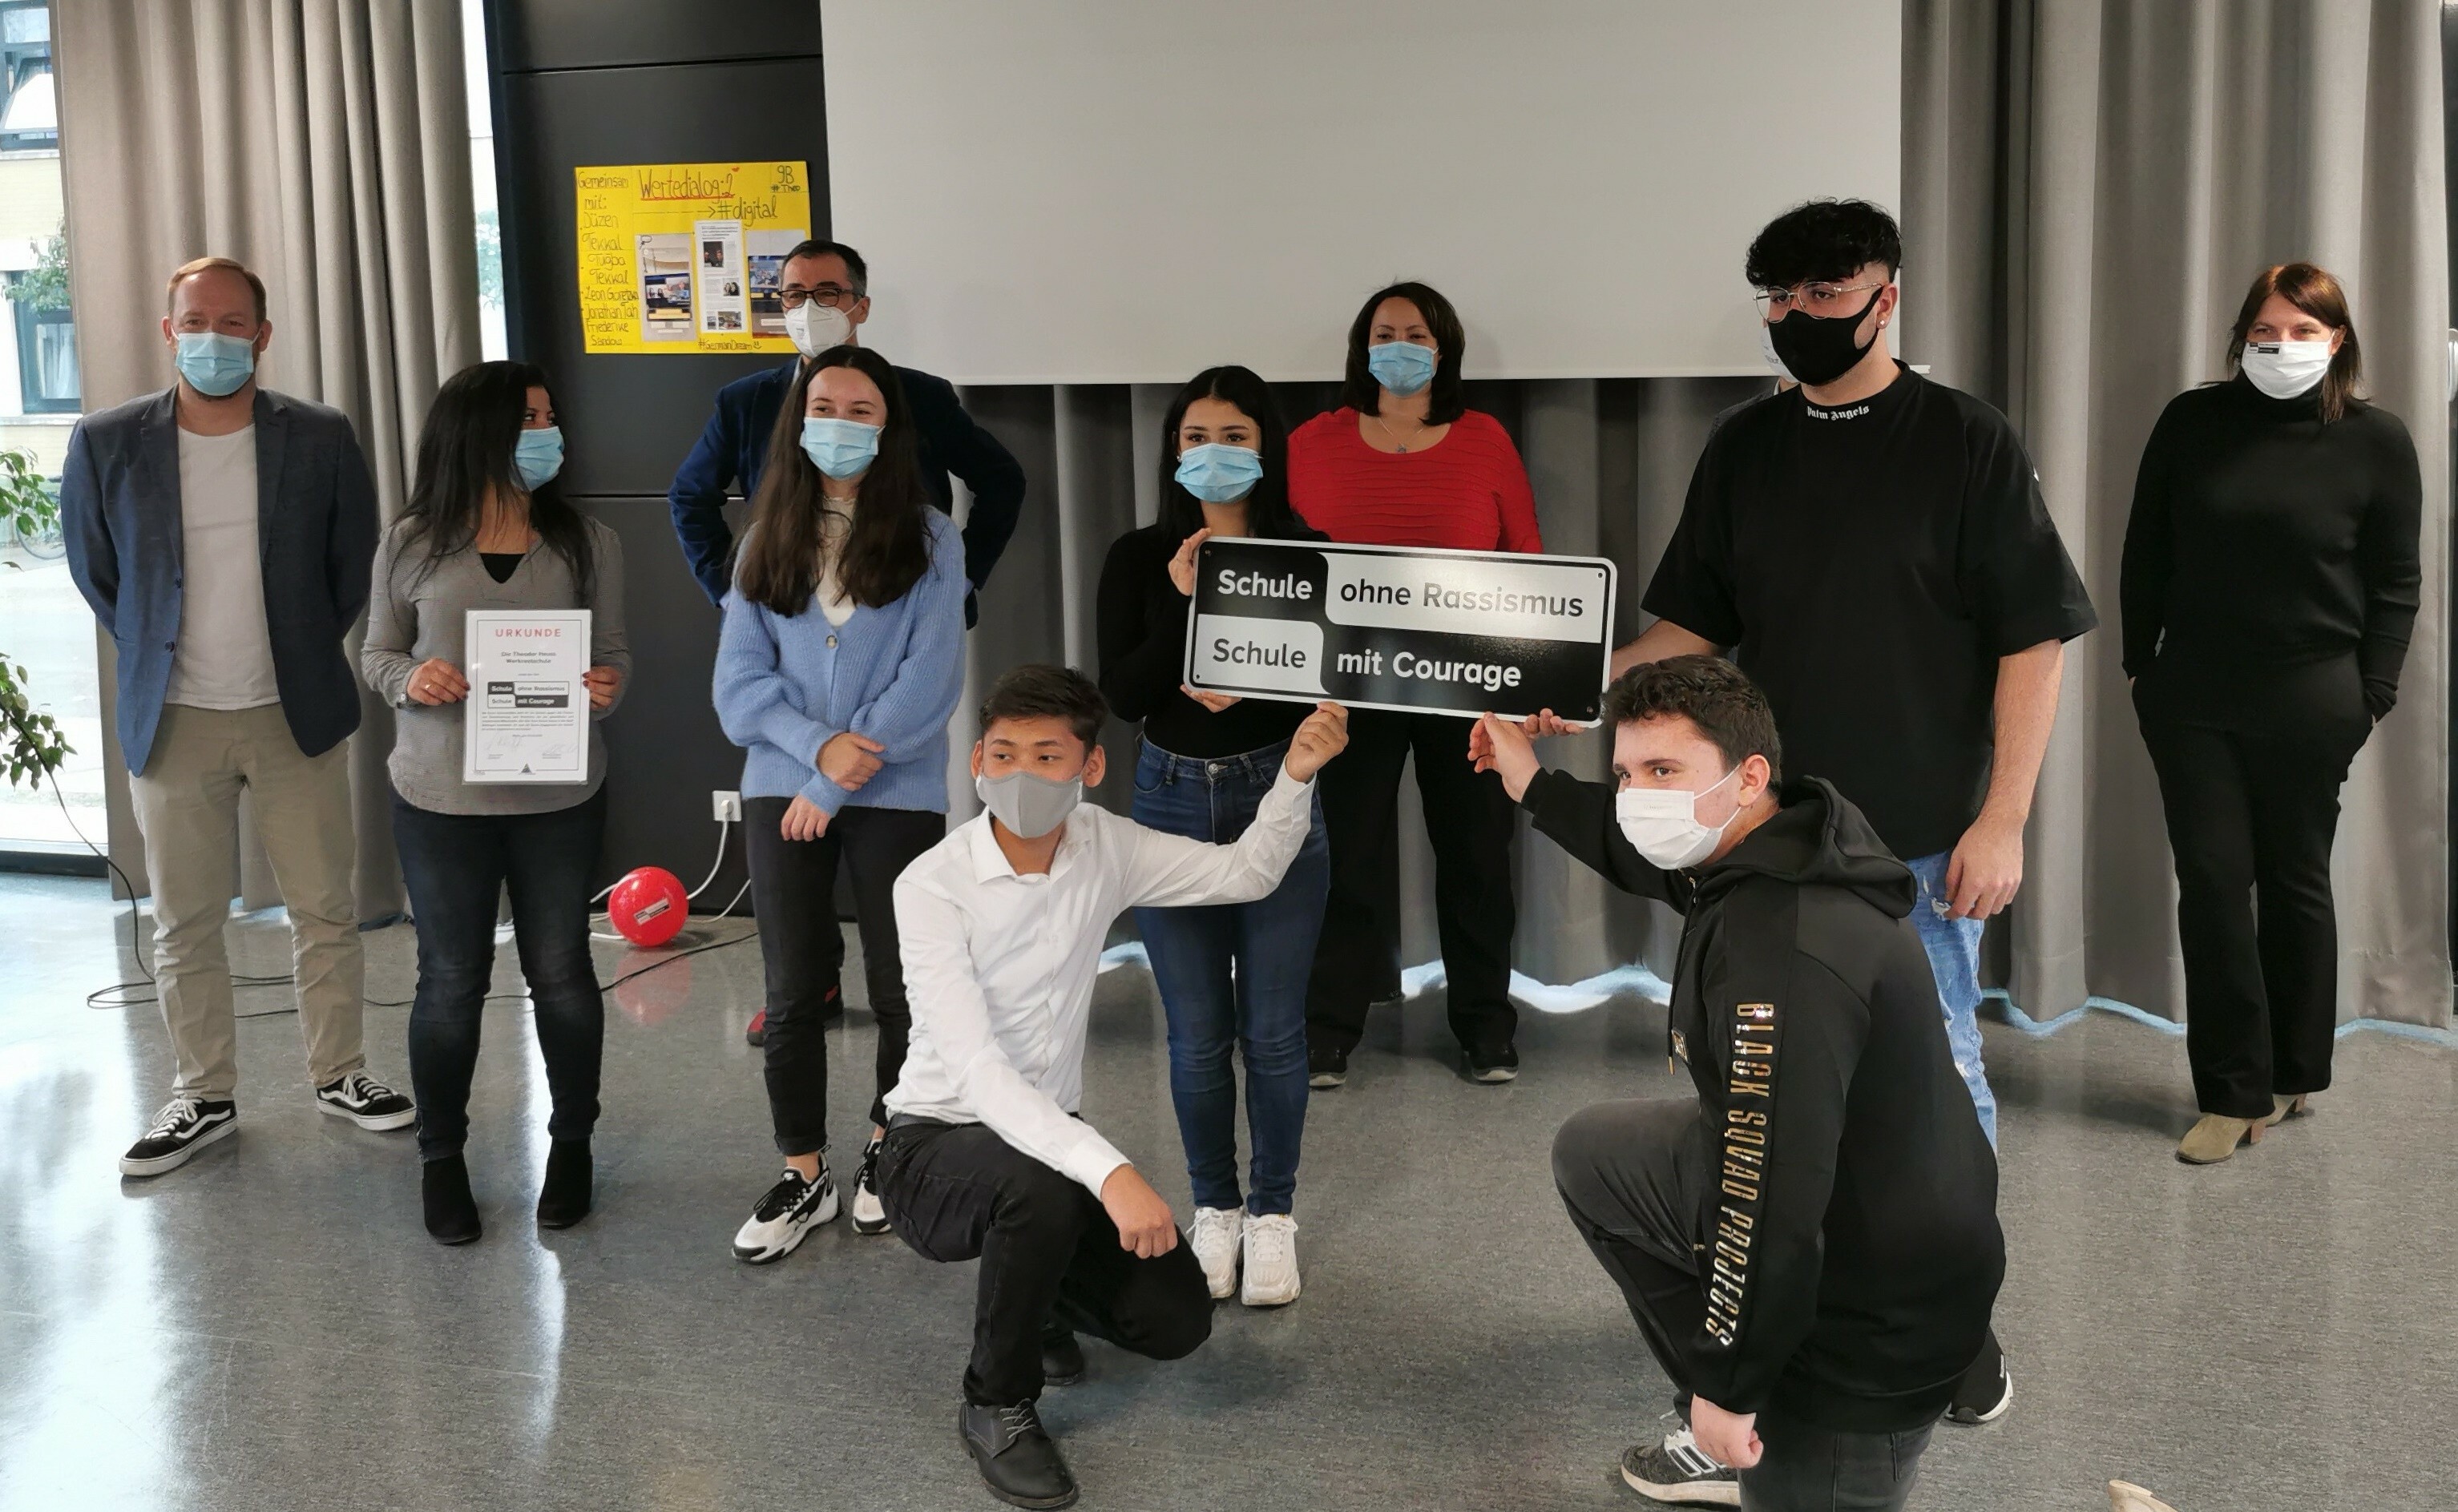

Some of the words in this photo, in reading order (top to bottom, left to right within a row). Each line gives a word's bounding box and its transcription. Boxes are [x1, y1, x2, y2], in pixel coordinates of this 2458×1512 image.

[578, 171, 629, 189] Gemeinsam
[777, 165, 794, 184] 9B
[717, 194, 778, 228] #digital
[1806, 405, 1828, 420] Palm
[1830, 405, 1870, 421] Angels
[1217, 569, 1313, 600] Schule
[1340, 577, 1411, 607] ohne
[1423, 582, 1584, 618] Rassismus
[495, 628, 561, 638] URKUNDE
[1212, 639, 1306, 668] Schule
[1337, 648, 1382, 676] mit
[1392, 651, 1522, 691] Courage
[1729, 1003, 1774, 1098] BLACK
[1705, 1204, 1755, 1347] PROJECTS
